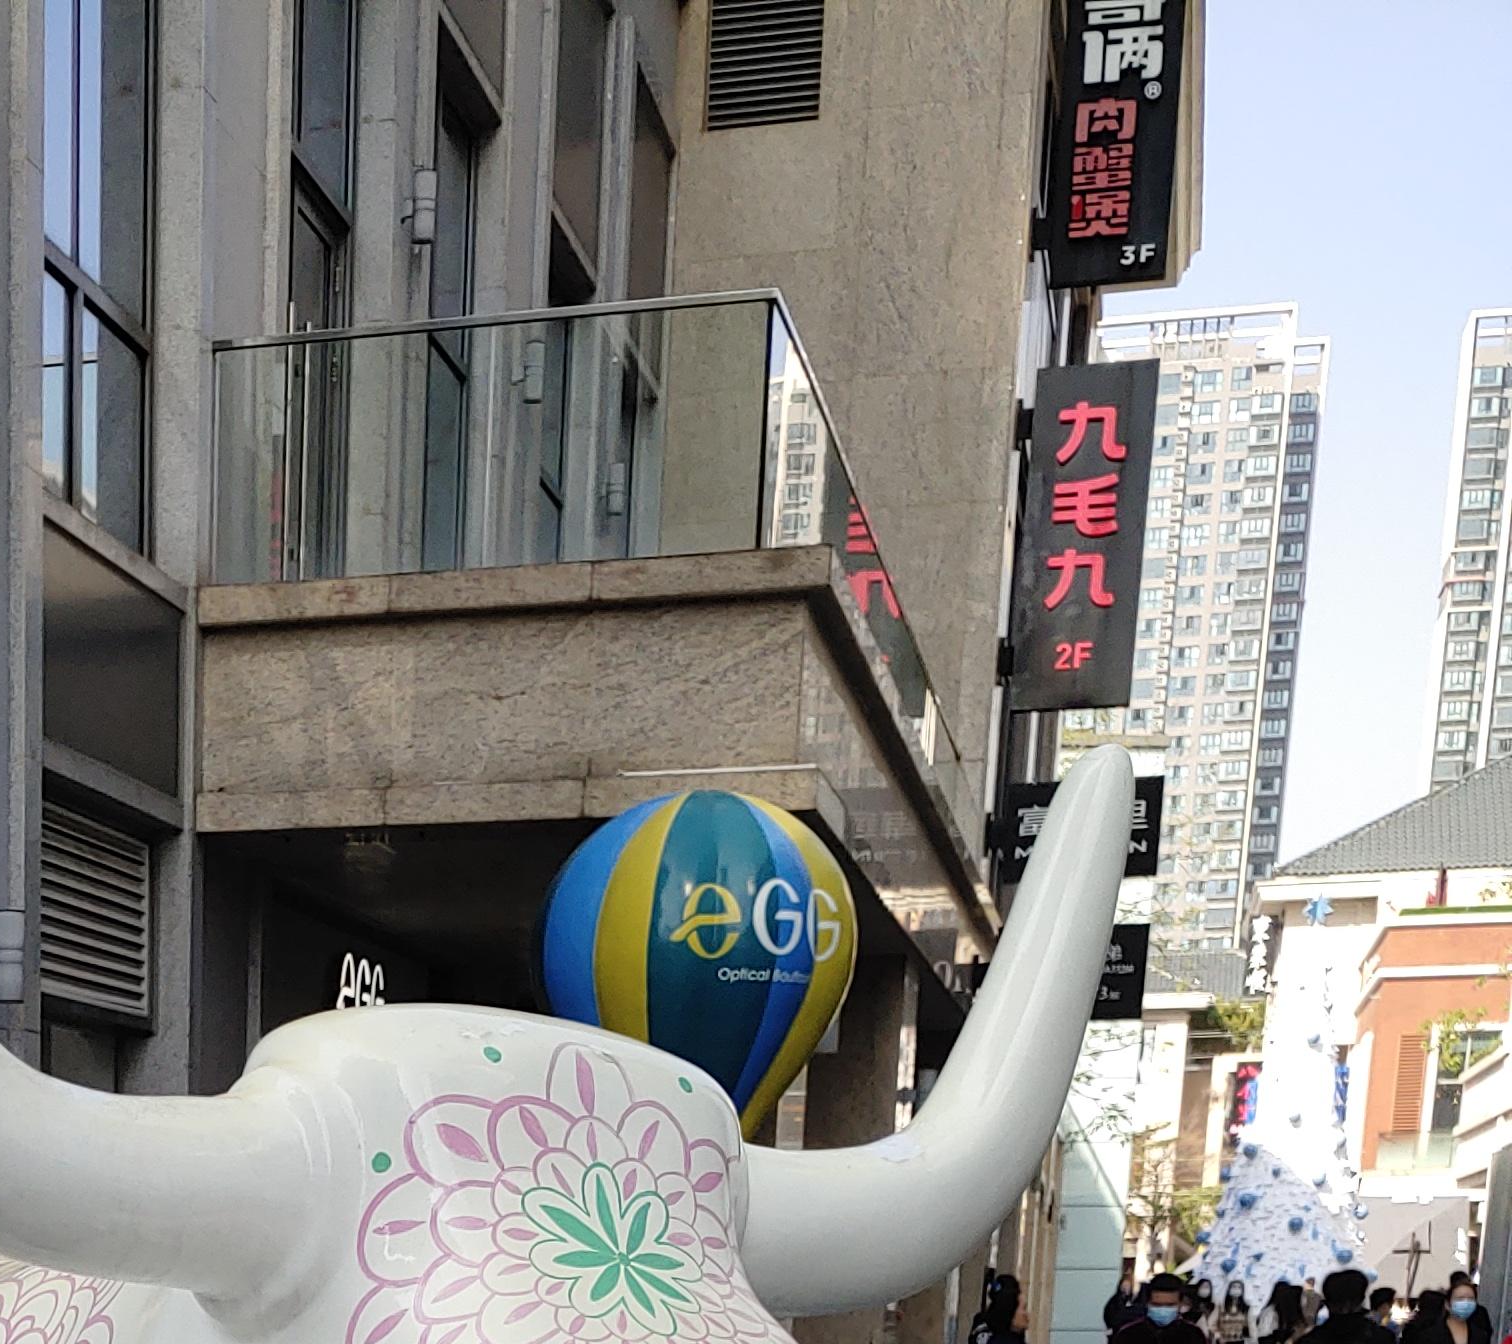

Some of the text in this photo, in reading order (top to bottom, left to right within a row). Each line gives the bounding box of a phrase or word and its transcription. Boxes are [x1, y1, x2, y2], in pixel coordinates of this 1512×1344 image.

[1119, 243, 1156, 265] 3F
[1043, 401, 1127, 611] 九毛九
[1053, 640, 1094, 671] 2F
